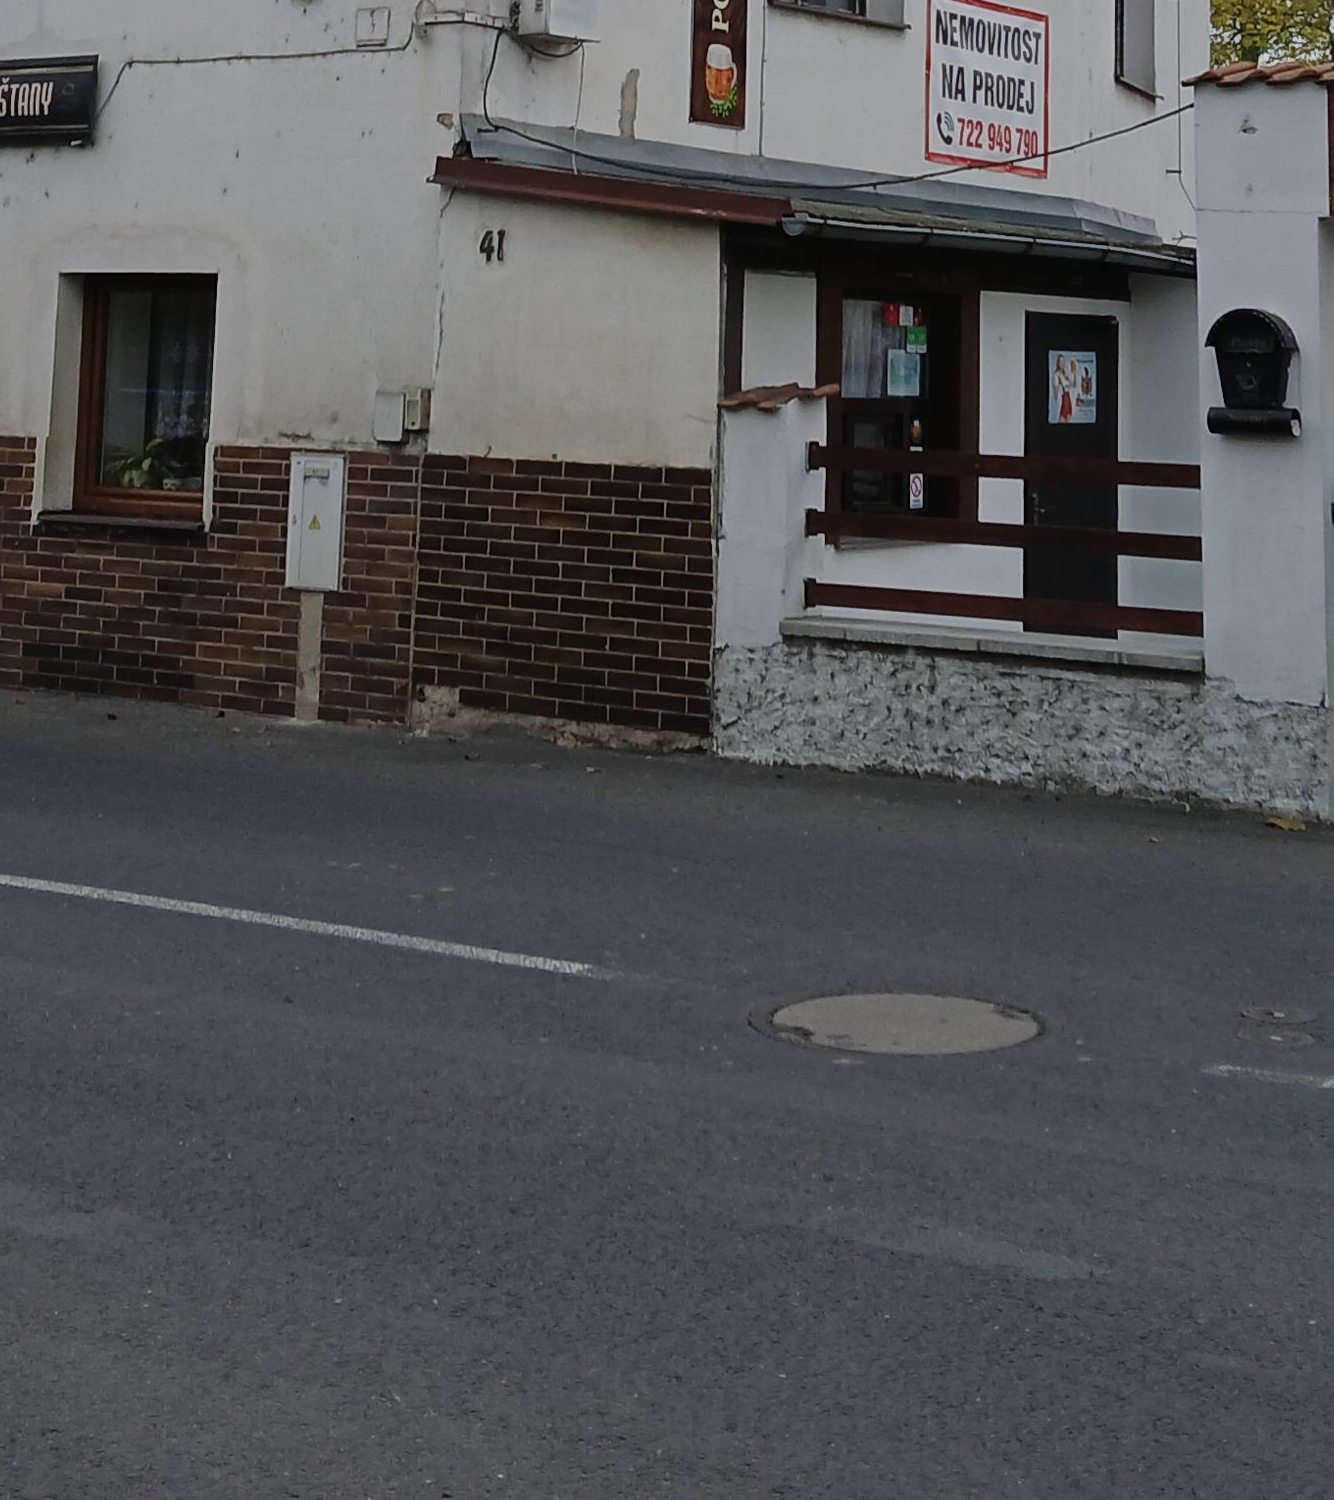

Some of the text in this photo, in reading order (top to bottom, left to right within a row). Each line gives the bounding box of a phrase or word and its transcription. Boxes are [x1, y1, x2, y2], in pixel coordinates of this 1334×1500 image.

[935, 9, 1042, 65] NEMOVITOST
[942, 63, 1035, 114] NA PRODEJ
[957, 117, 1038, 157] 722 949 790
[479, 229, 506, 262] 41
